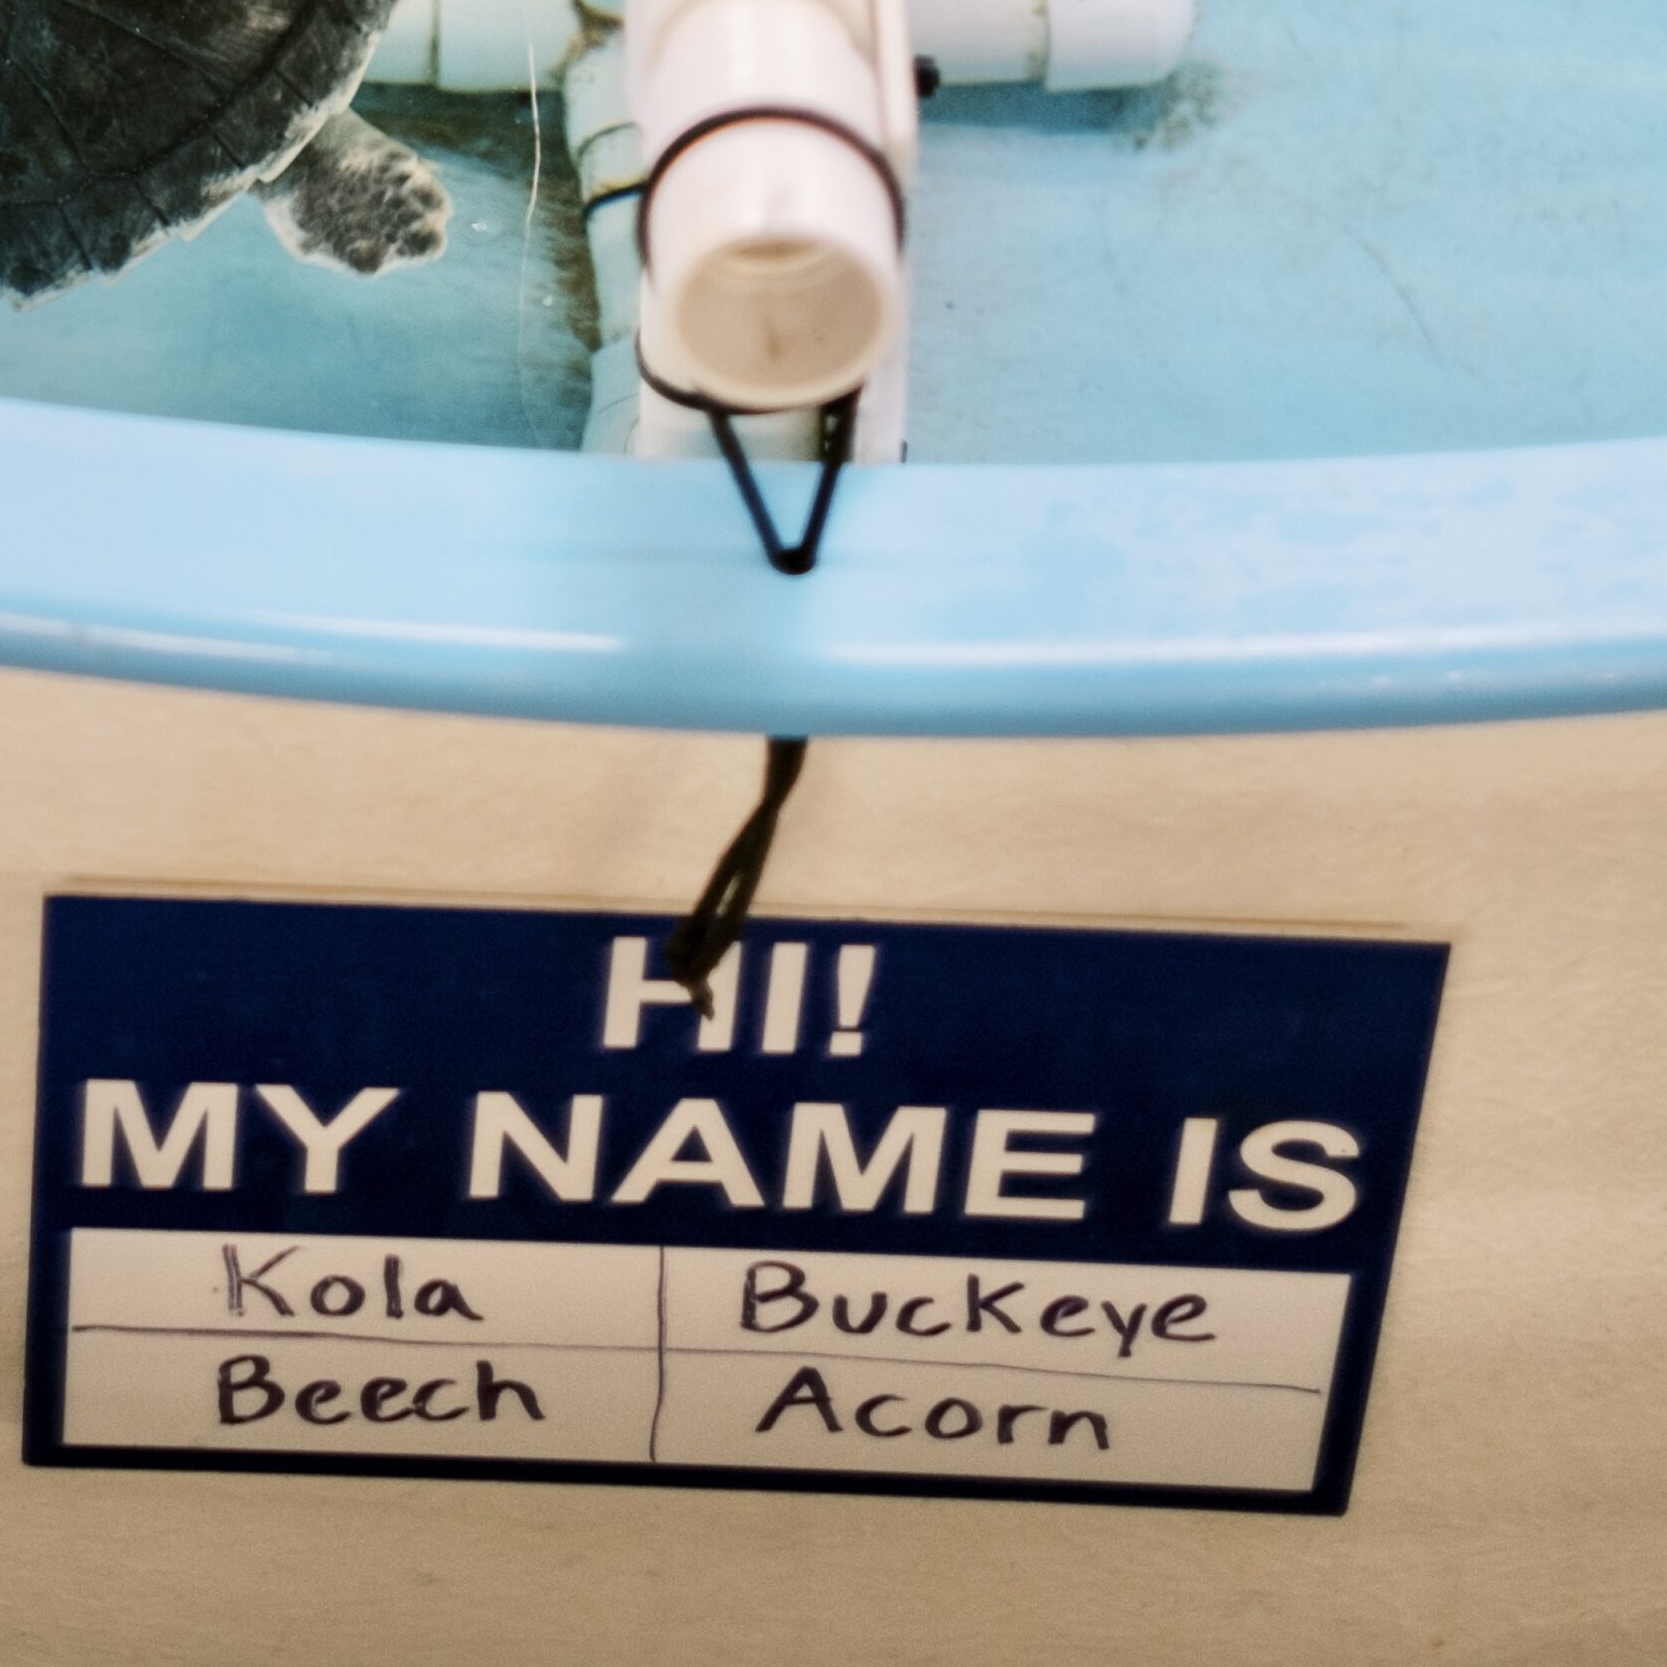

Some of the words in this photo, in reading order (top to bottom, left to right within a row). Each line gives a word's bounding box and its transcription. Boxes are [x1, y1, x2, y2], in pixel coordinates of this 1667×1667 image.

[601, 935, 877, 1057] HI!
[80, 1078, 400, 1194] MY
[467, 1090, 1097, 1220] NAME
[1166, 1116, 1361, 1231] IS
[220, 1242, 485, 1323] Kola
[216, 1353, 547, 1427] Beech
[753, 1364, 1112, 1452] Acorn
